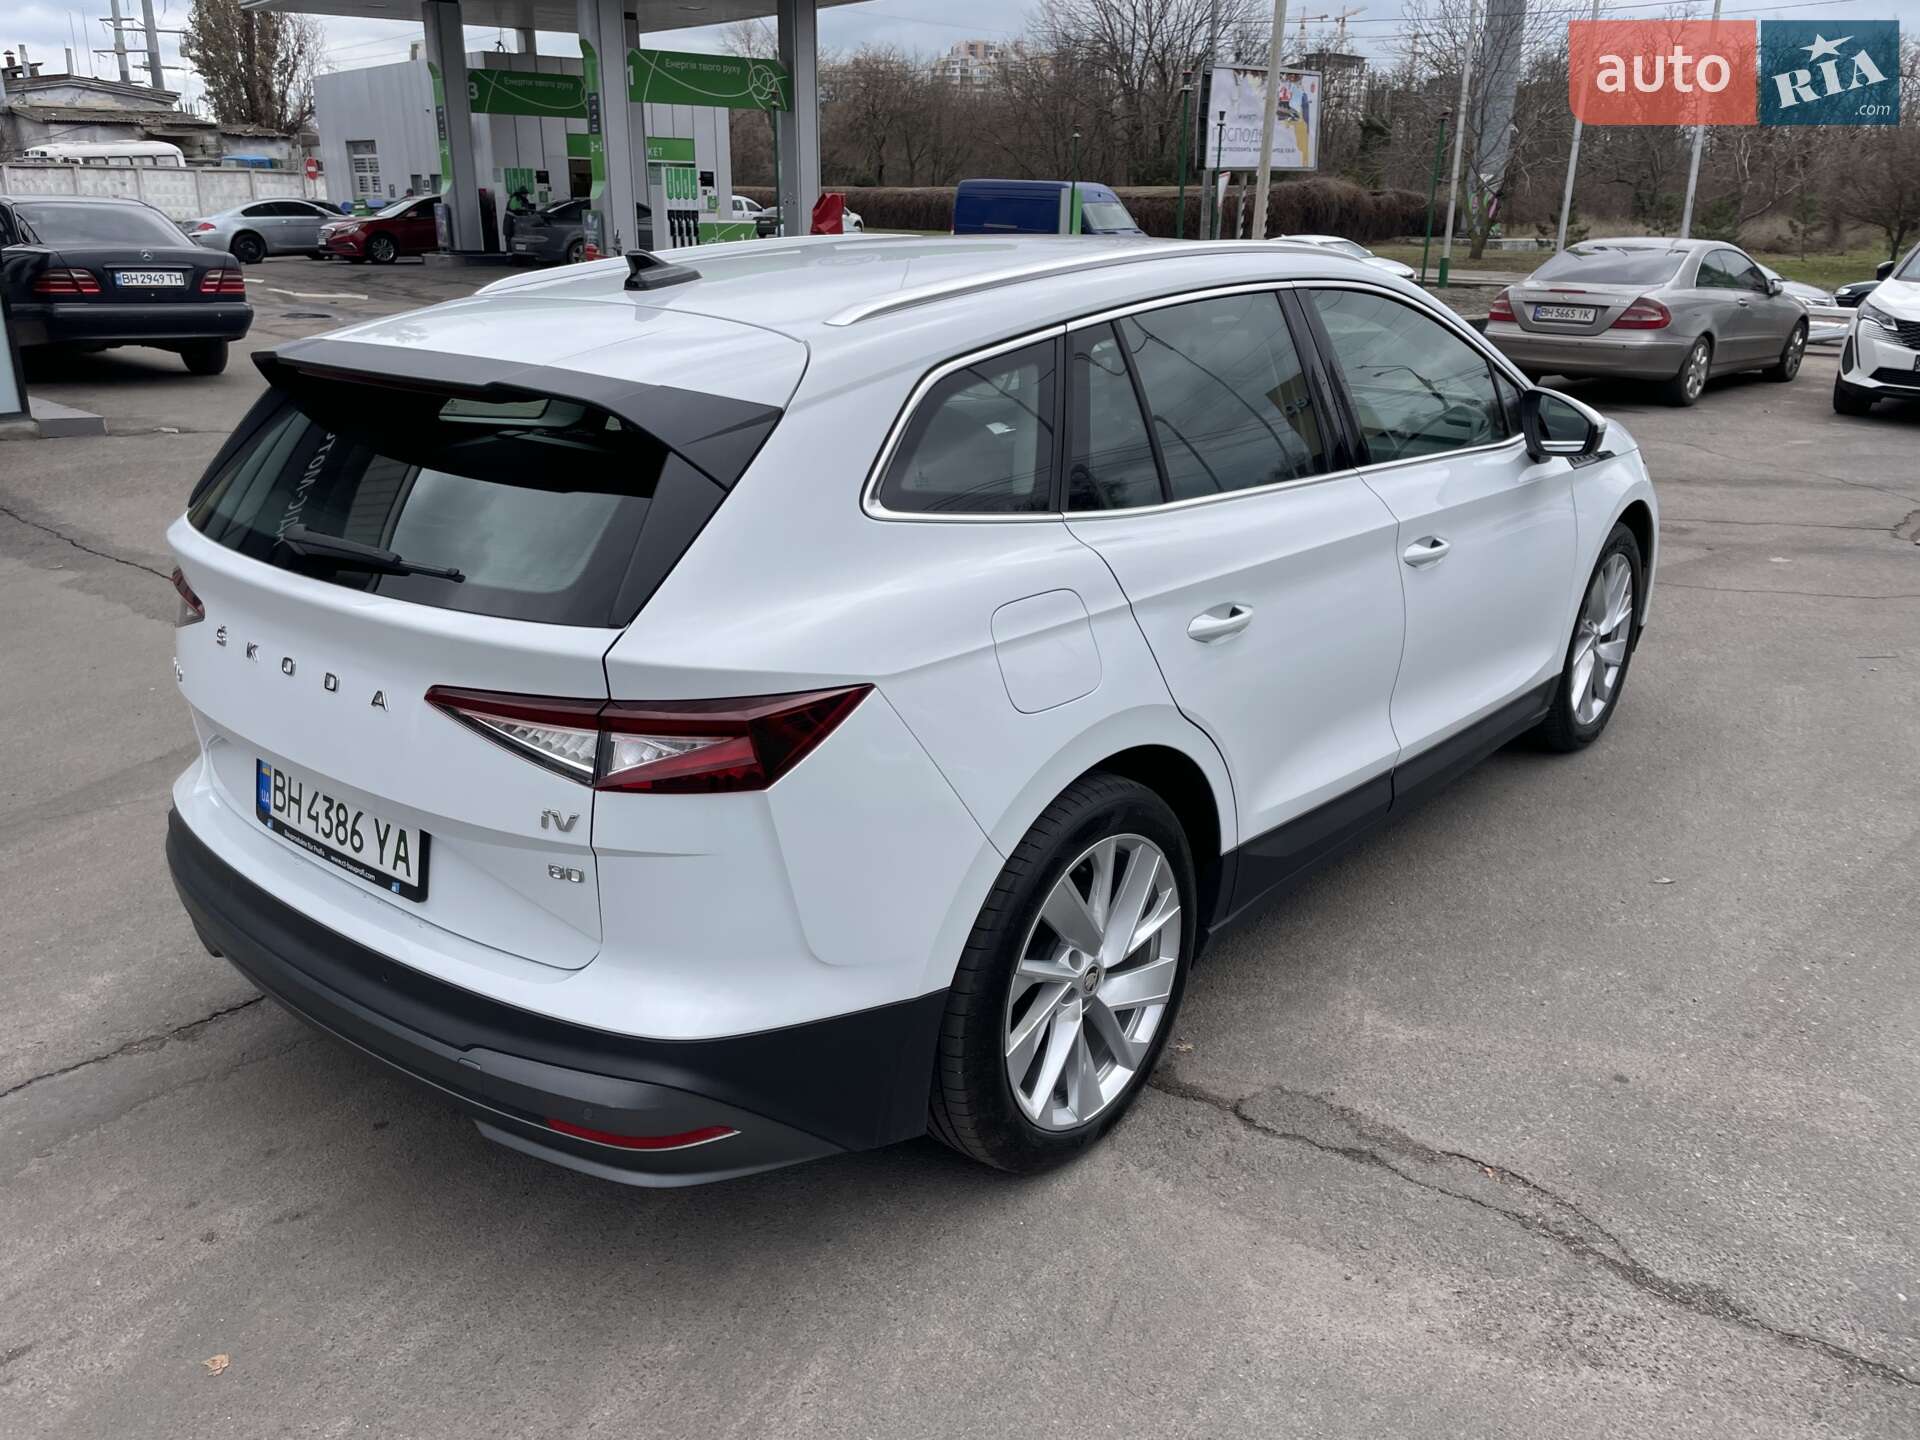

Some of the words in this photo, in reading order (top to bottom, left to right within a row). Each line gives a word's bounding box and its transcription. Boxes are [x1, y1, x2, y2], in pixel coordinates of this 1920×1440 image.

[468, 82, 479, 100] 3
[122, 273, 139, 284] BH
[140, 273, 165, 285] 2949
[166, 273, 183, 284] TH
[1540, 305, 1554, 317] BH
[1555, 308, 1577, 318] 5665
[261, 789, 270, 804] UA
[273, 768, 303, 825] BH
[306, 791, 364, 854] 4386
[374, 817, 411, 878] YA
[548, 864, 585, 883] 80
